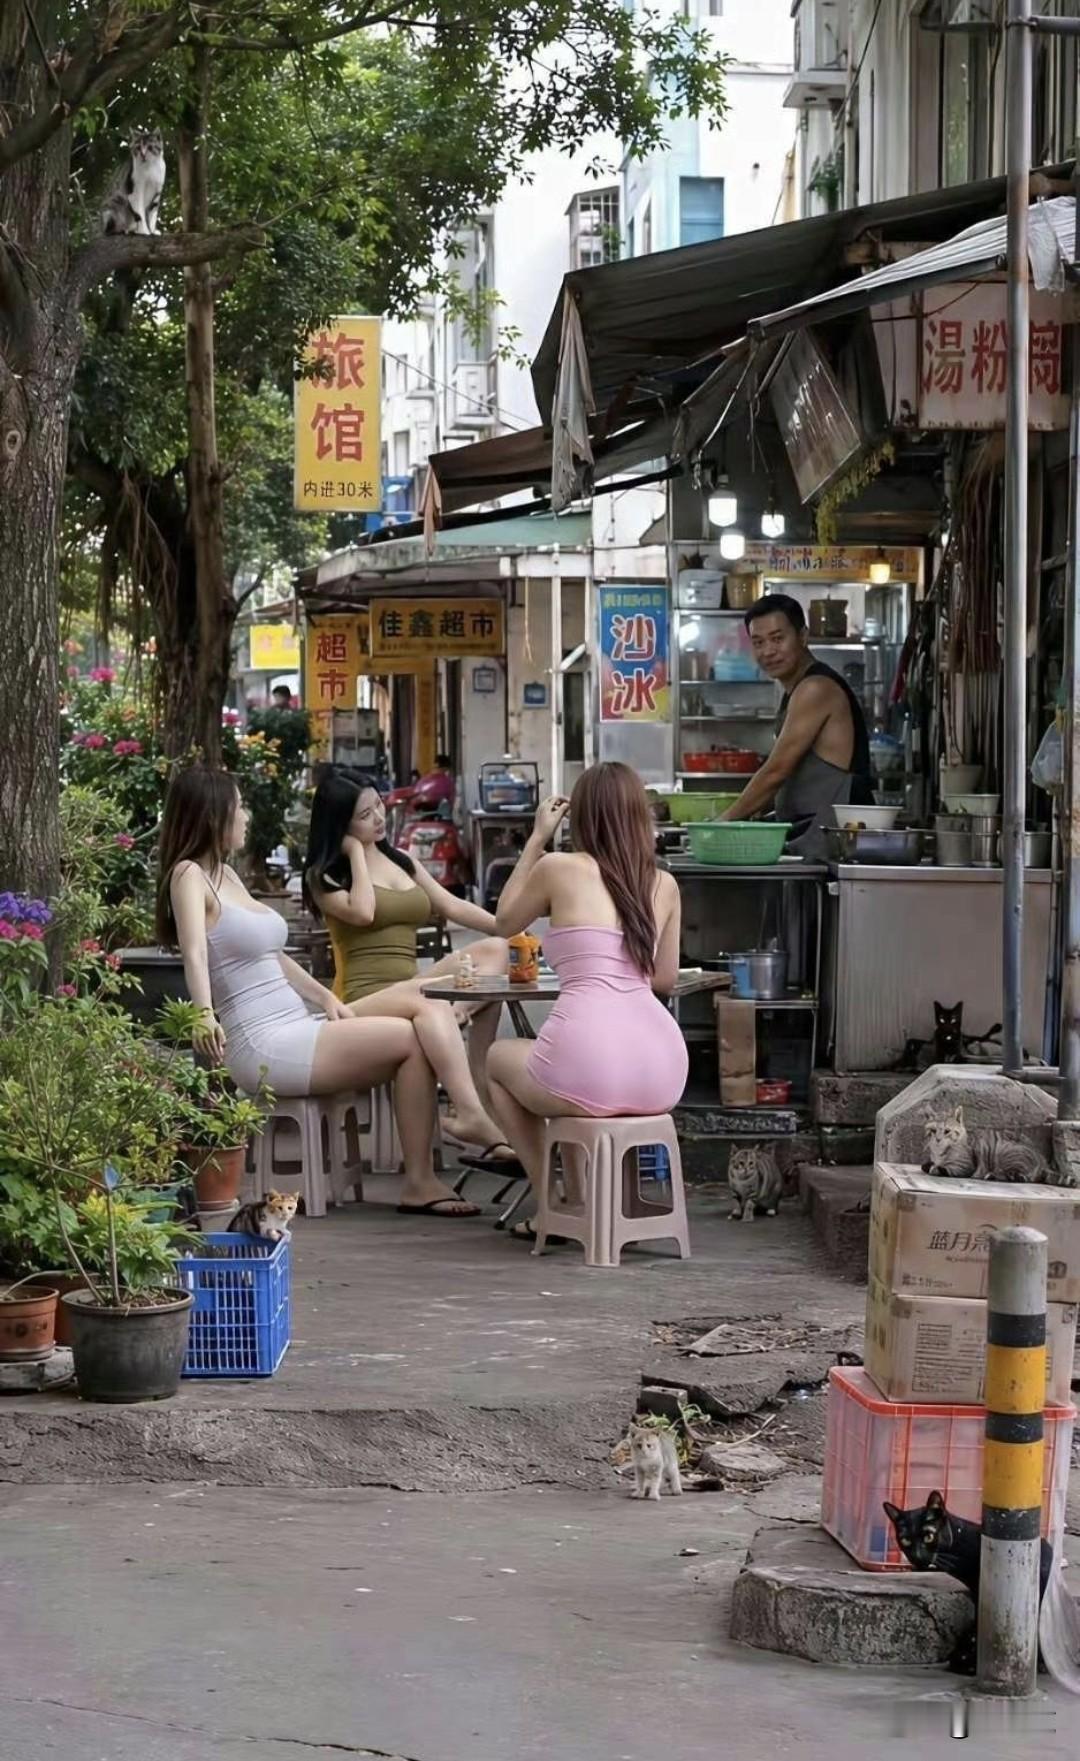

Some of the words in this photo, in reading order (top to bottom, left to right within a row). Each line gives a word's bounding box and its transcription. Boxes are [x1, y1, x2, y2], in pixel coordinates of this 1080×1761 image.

[311, 331, 365, 462] 旅馆
[315, 631, 349, 701] 超市
[377, 608, 497, 639] 佳鑫超市
[610, 613, 657, 715] 沙冰
